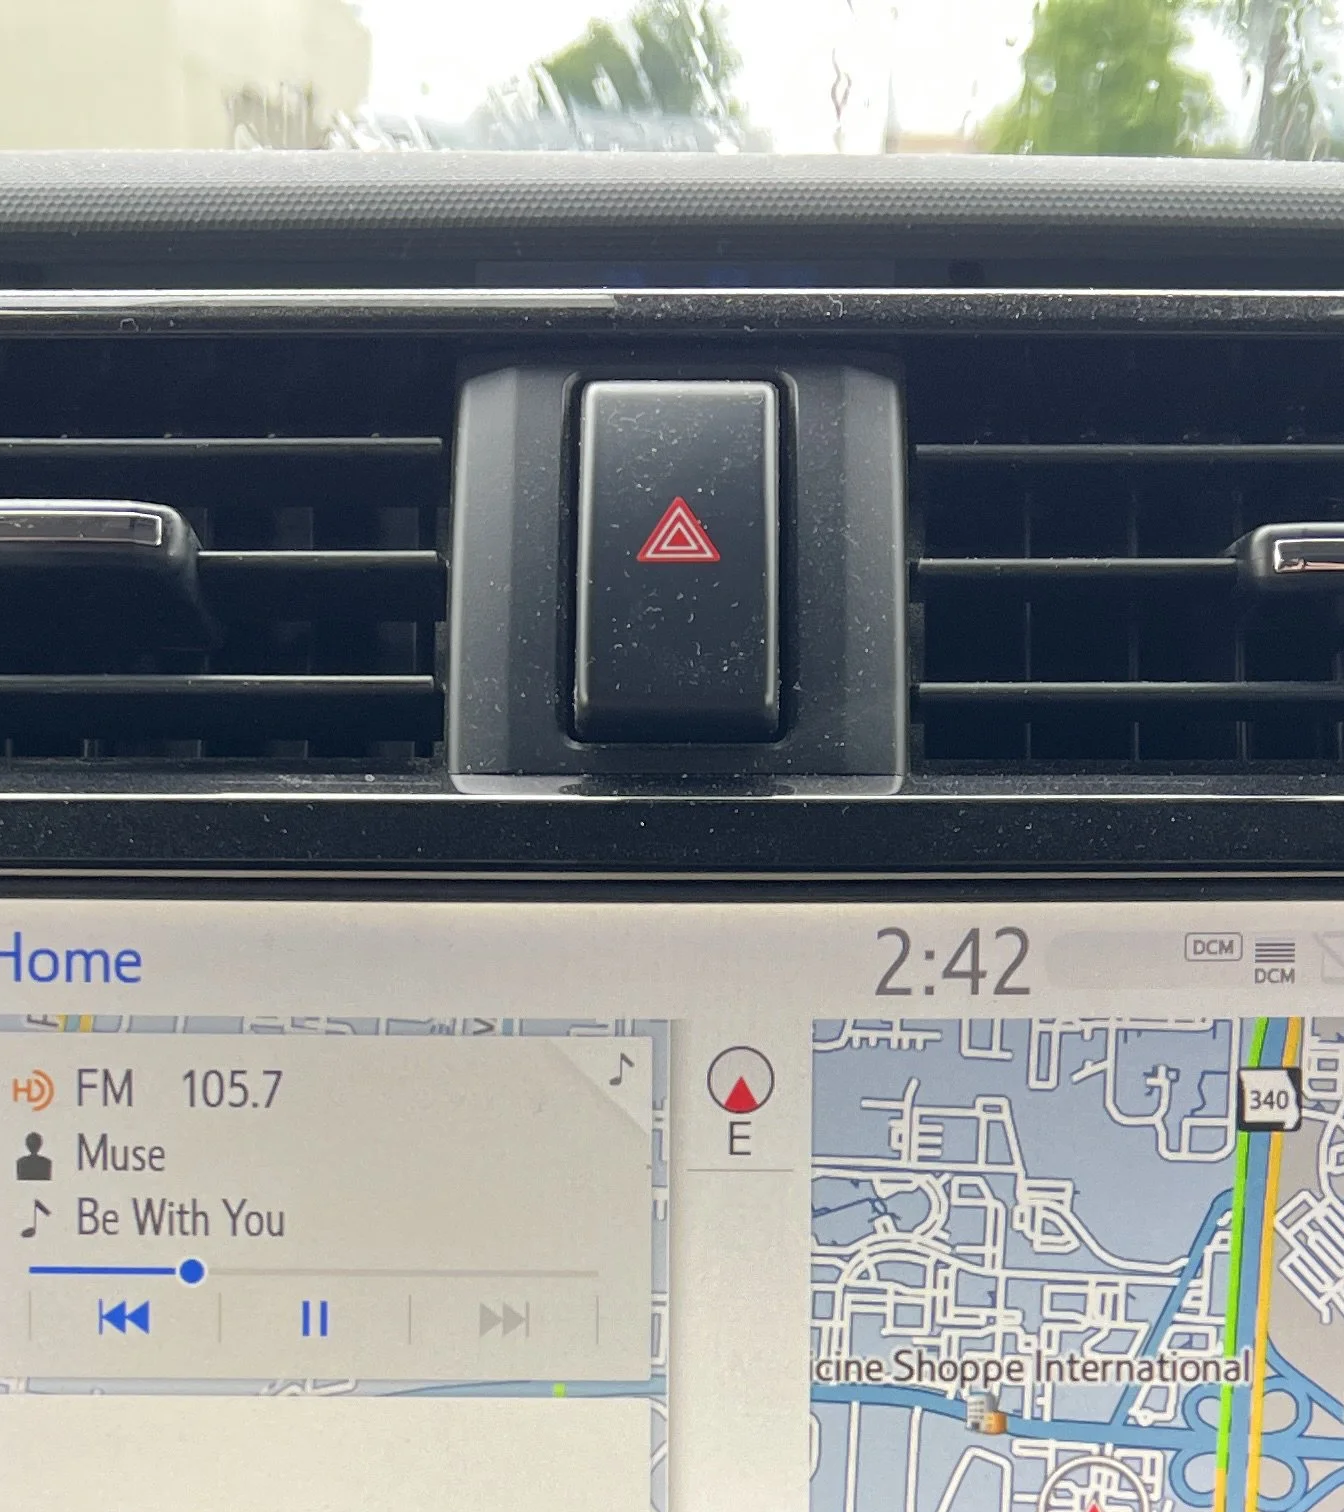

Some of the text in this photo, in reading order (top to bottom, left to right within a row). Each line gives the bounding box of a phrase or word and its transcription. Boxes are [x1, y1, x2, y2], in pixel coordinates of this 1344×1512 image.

[875, 927, 1031, 996] 2:42
[1193, 939, 1235, 957] DCM
[1254, 967, 1296, 985] DCM
[76, 1068, 134, 1107] FM
[182, 1069, 283, 1108] 105.7
[1250, 1089, 1289, 1111] 340
[76, 1133, 166, 1172] Muse
[729, 1121, 751, 1156] E
[77, 1197, 286, 1237] Be With You
[893, 1350, 1023, 1391] Shoppe
[1036, 1352, 1251, 1383] International
